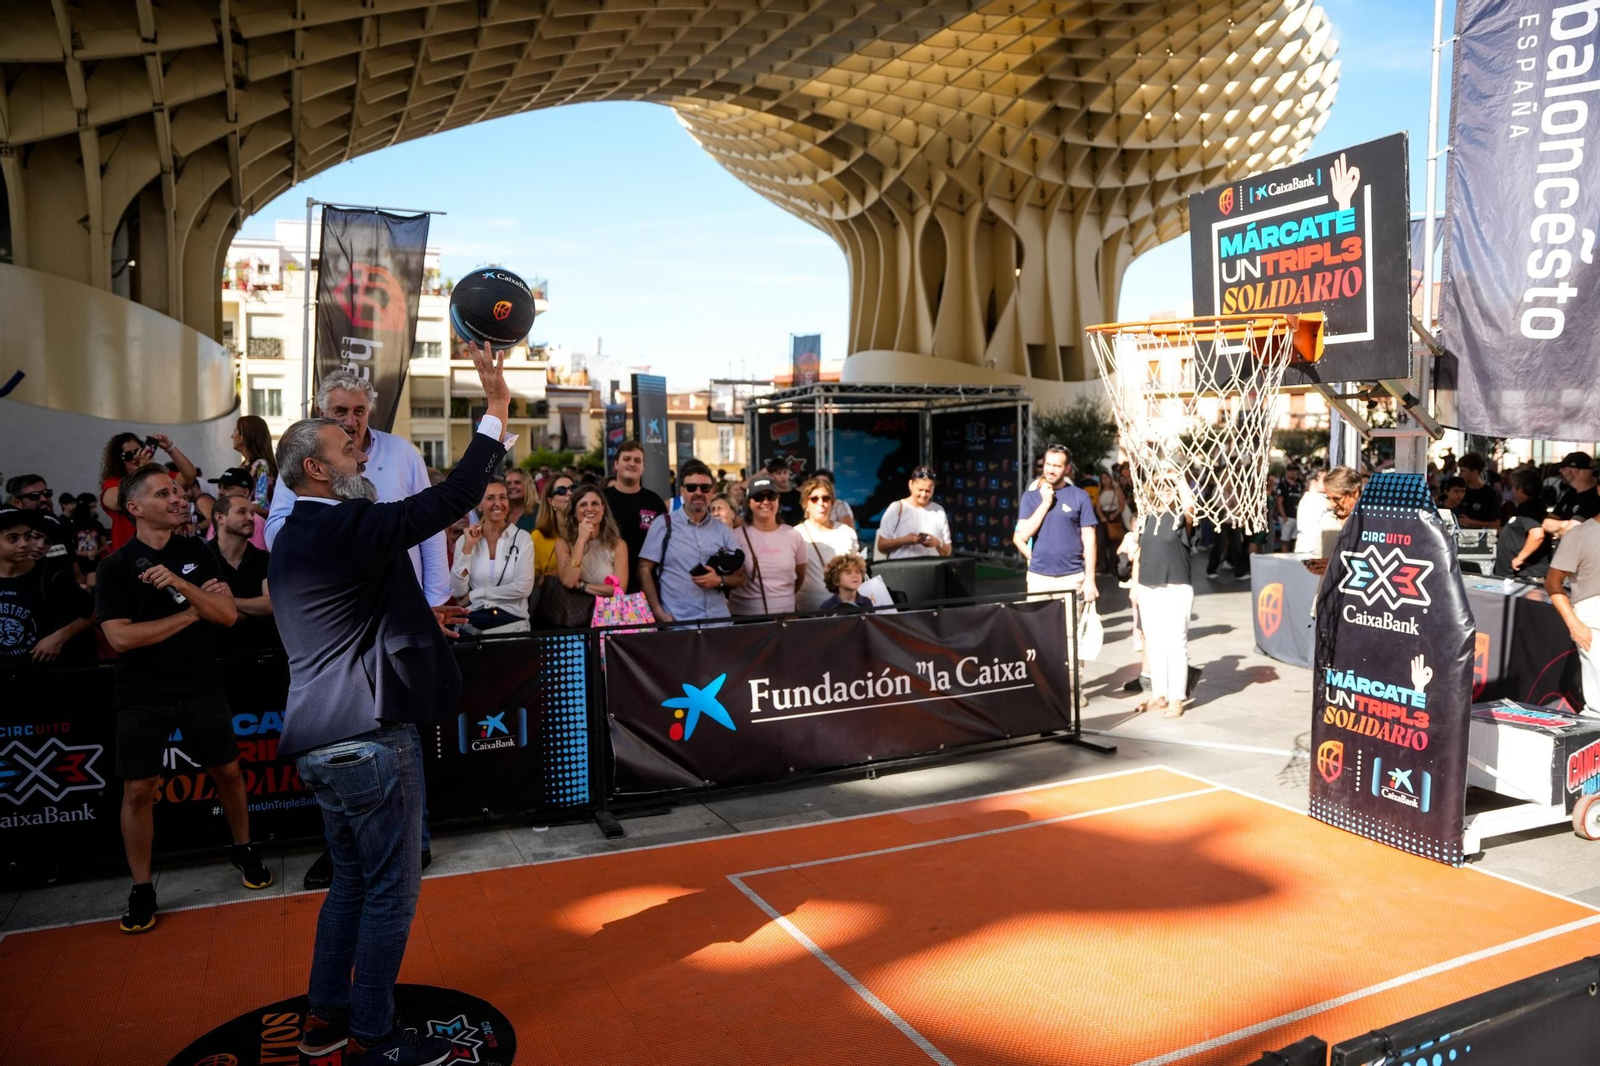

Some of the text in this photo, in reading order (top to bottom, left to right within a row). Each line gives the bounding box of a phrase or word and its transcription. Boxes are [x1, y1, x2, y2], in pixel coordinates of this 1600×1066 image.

[1510, 13, 1540, 139] ESPAÑA
[1268, 174, 1315, 196] CaixaBank
[1220, 207, 1356, 259] MÁRCATE
[1222, 266, 1363, 315] SOLIDARIO
[1361, 530, 1412, 546] CIRCUITO
[1343, 604, 1420, 636] CaixaBank
[748, 671, 911, 714] Fundación
[1325, 668, 1427, 709] MÁRCATE
[0, 722, 70, 738] CIRCUITO
[1323, 705, 1429, 751] SOLIDARIO
[471, 738, 516, 751] CaixaBank
[1381, 788, 1419, 809] CaixaBank
[0, 803, 97, 828] aixaBank
